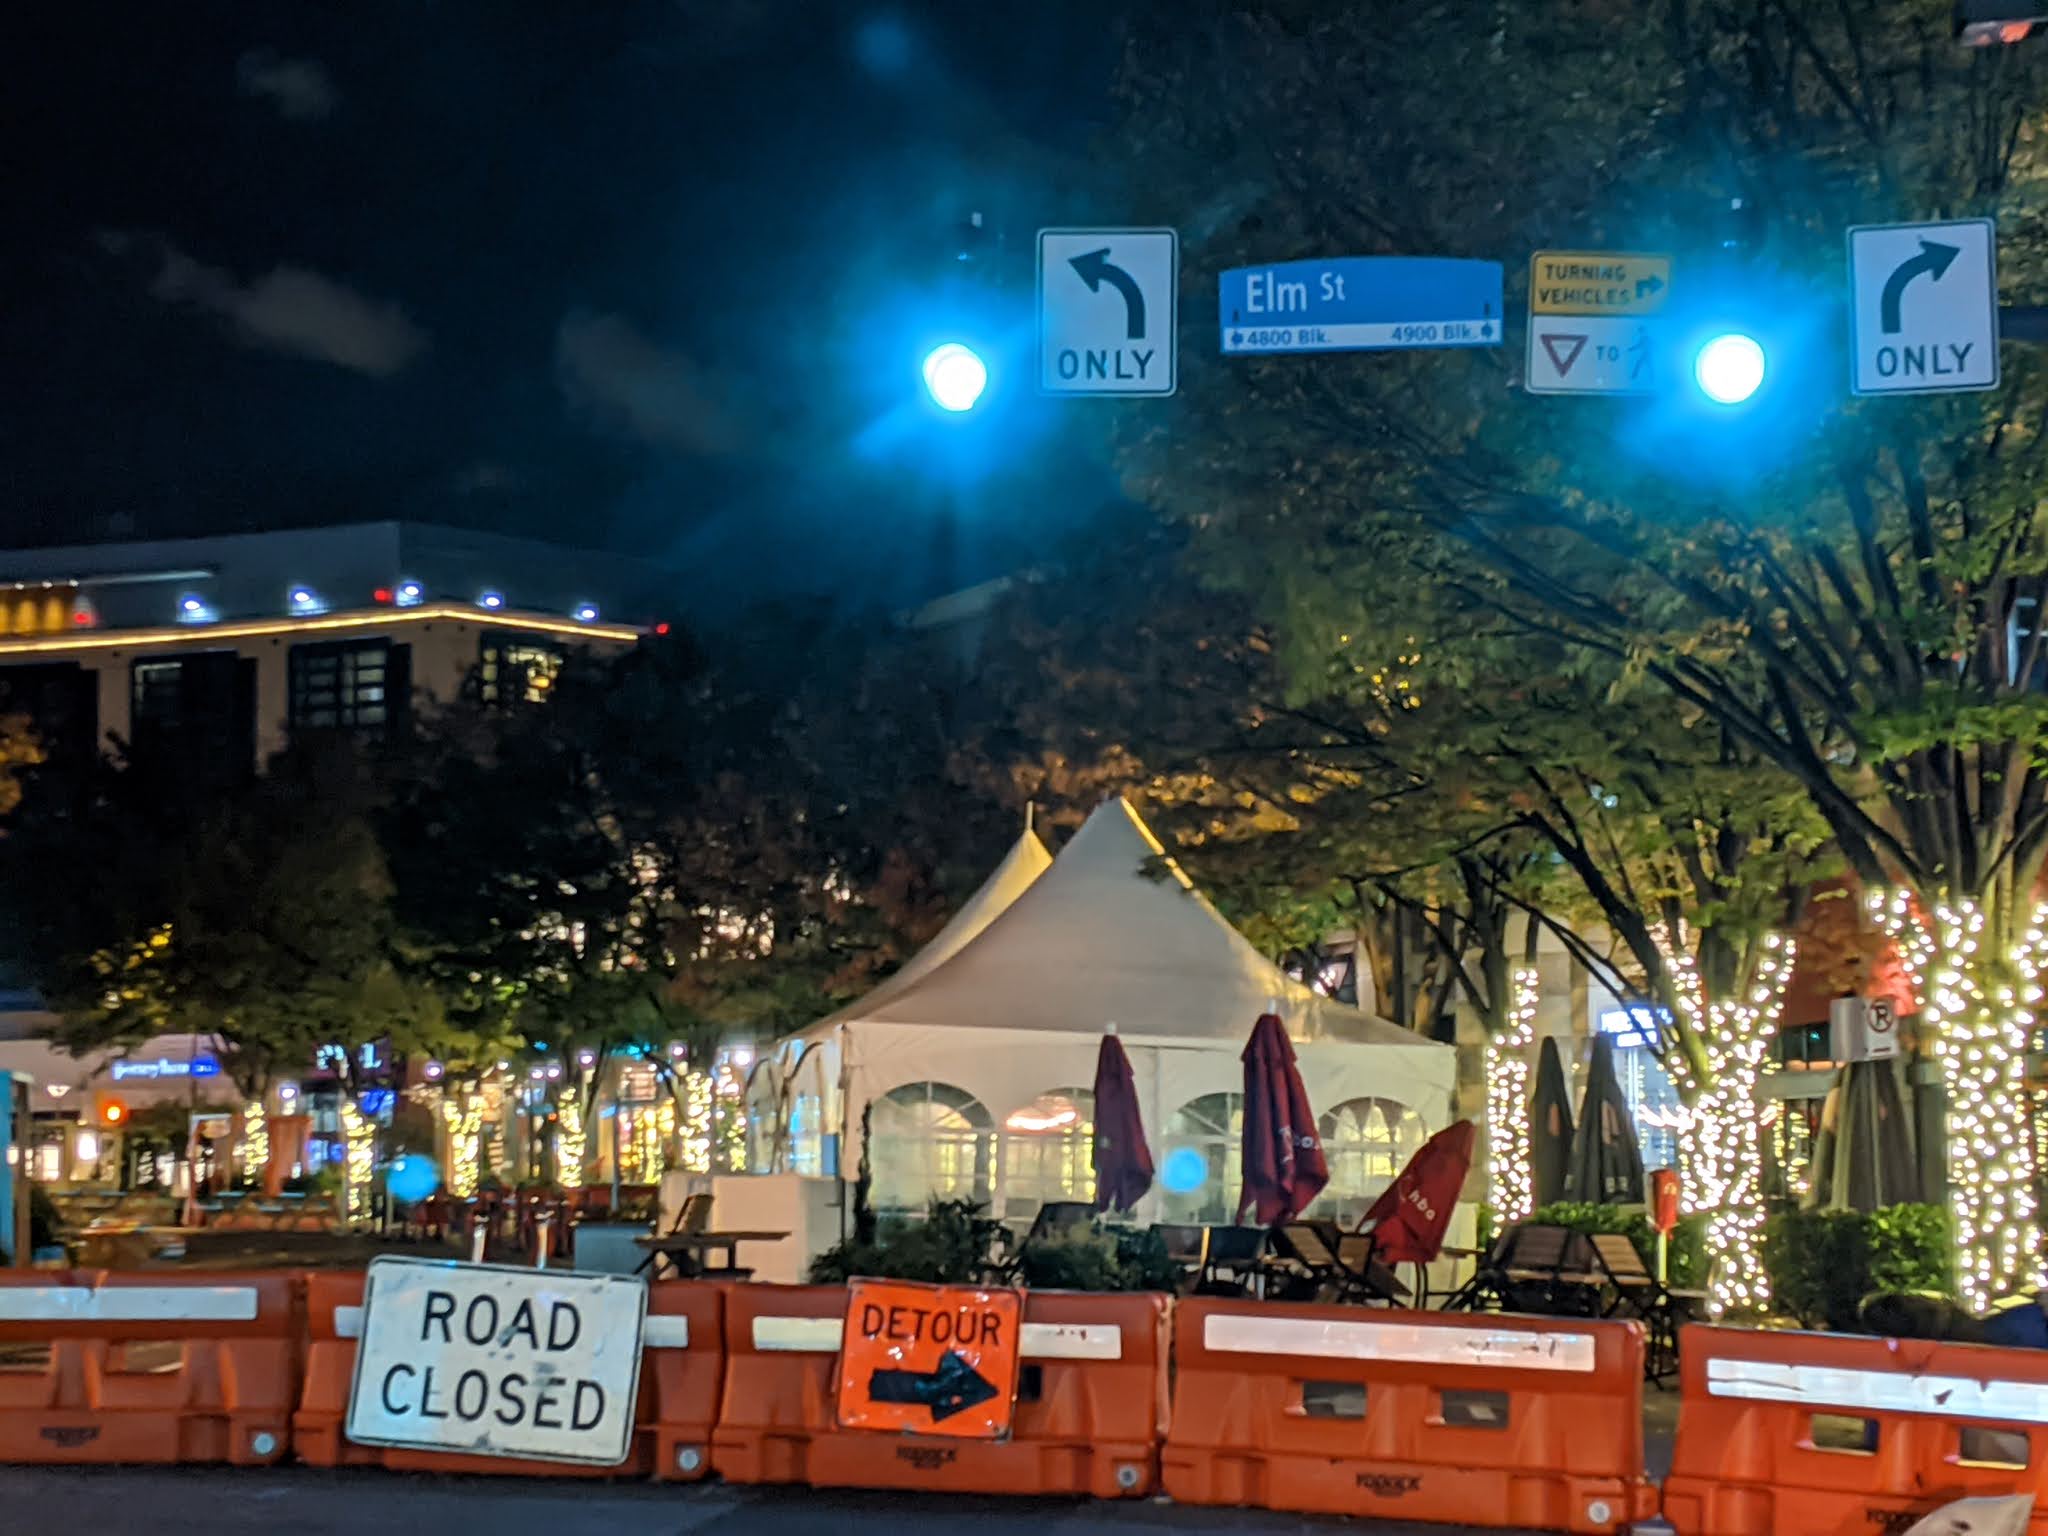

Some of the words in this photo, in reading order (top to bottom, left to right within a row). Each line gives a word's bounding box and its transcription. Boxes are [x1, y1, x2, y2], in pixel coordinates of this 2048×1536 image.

[1544, 264, 1627, 282] TURNING
[1246, 270, 1307, 313] Elm
[1320, 271, 1346, 301] St
[1538, 288, 1632, 305] VEHICLES
[1248, 329, 1293, 345] 4800
[1391, 325, 1438, 342] 4900
[1058, 349, 1155, 379] ONLY
[1595, 345, 1620, 361] TO
[1876, 342, 1974, 377] ONLY
[421, 1290, 581, 1351] ROAD
[862, 1304, 1001, 1345] DETOUR
[382, 1363, 605, 1431] CLOSED
